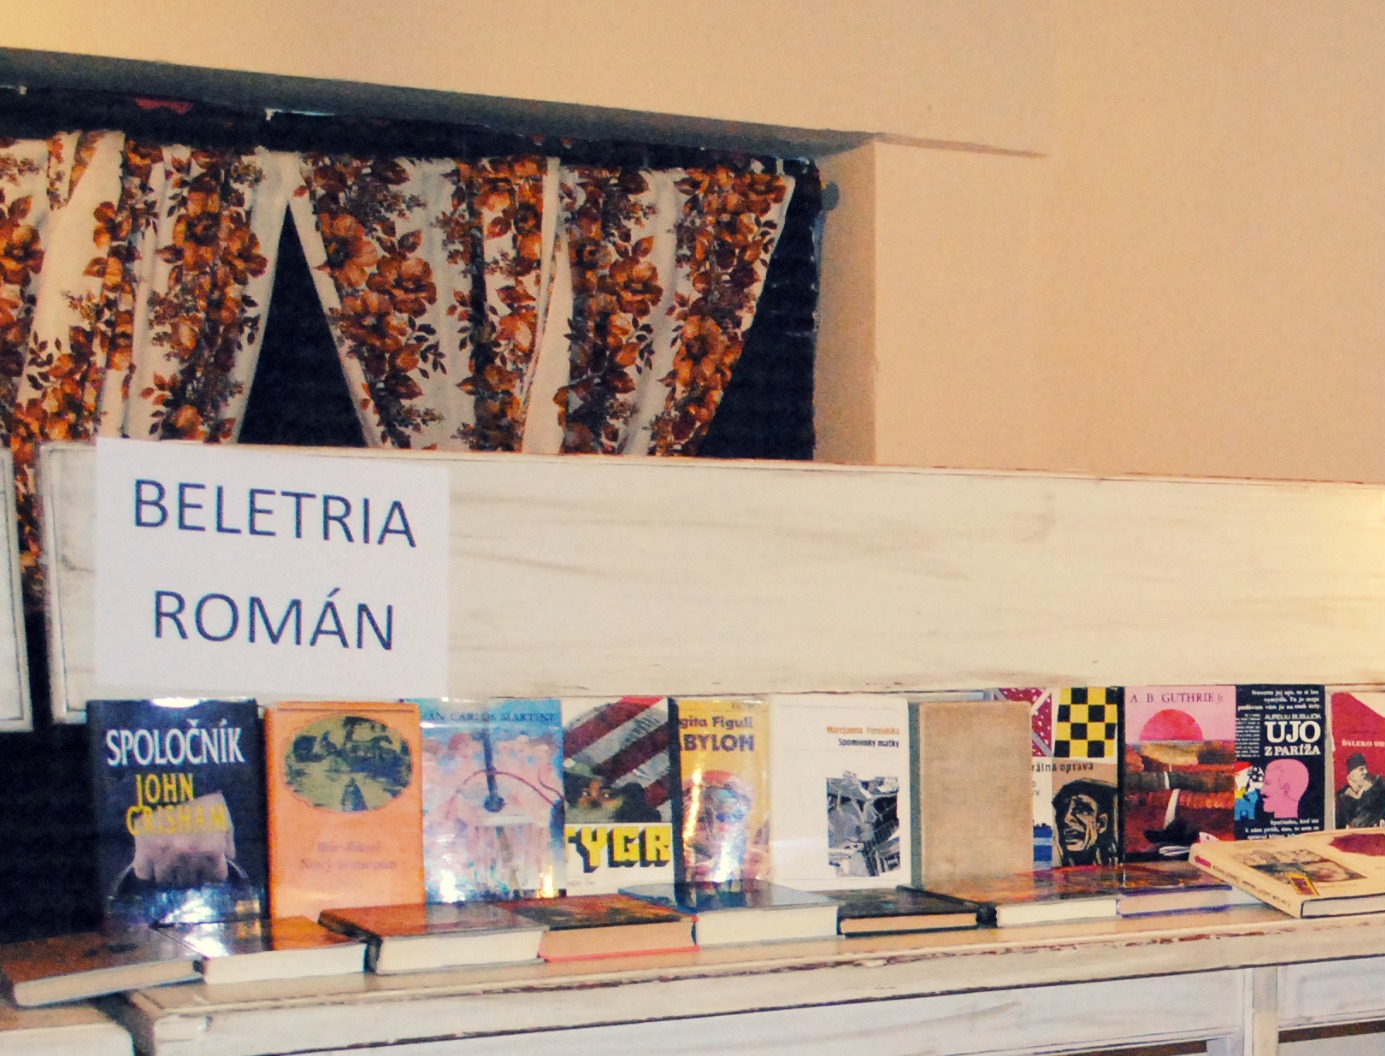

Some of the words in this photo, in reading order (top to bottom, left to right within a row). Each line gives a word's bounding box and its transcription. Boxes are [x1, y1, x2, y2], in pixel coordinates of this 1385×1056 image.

[135, 479, 417, 548] BELETRIA
[154, 588, 394, 651] ROMÁN
[1161, 693, 1214, 703] GUTHRIE
[106, 718, 245, 766] SPOLOČNÍK
[680, 733, 754, 752] BYLON
[1264, 720, 1321, 743] UJO
[1264, 746, 1273, 756] Z
[1274, 743, 1321, 756] PARÍŽA
[1060, 762, 1094, 774] oprava
[135, 772, 195, 809] JOHN
